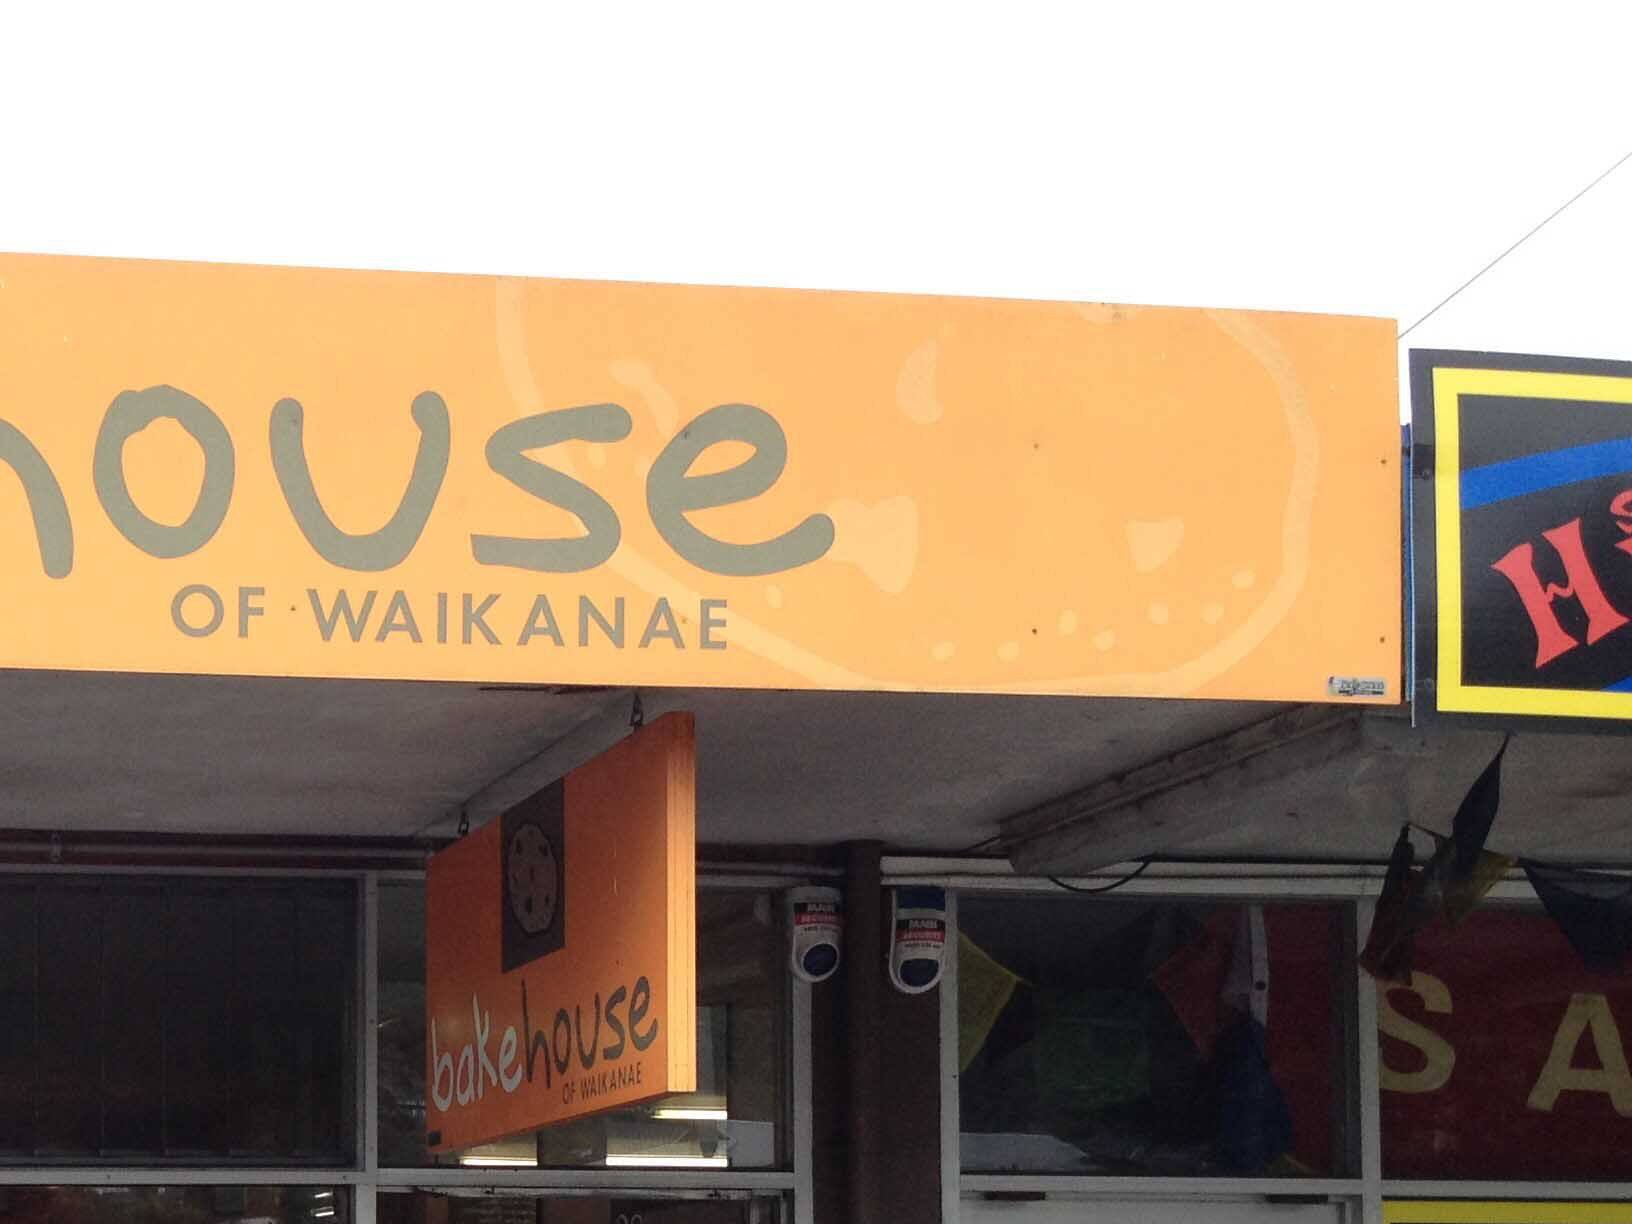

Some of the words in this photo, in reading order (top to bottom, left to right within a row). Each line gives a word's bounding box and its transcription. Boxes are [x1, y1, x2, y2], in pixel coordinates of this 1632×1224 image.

[171, 583, 265, 638] OF
[307, 588, 728, 649] WAIKANAE
[562, 1084, 576, 1105] OF
[580, 1062, 642, 1104] WAIKANAE
